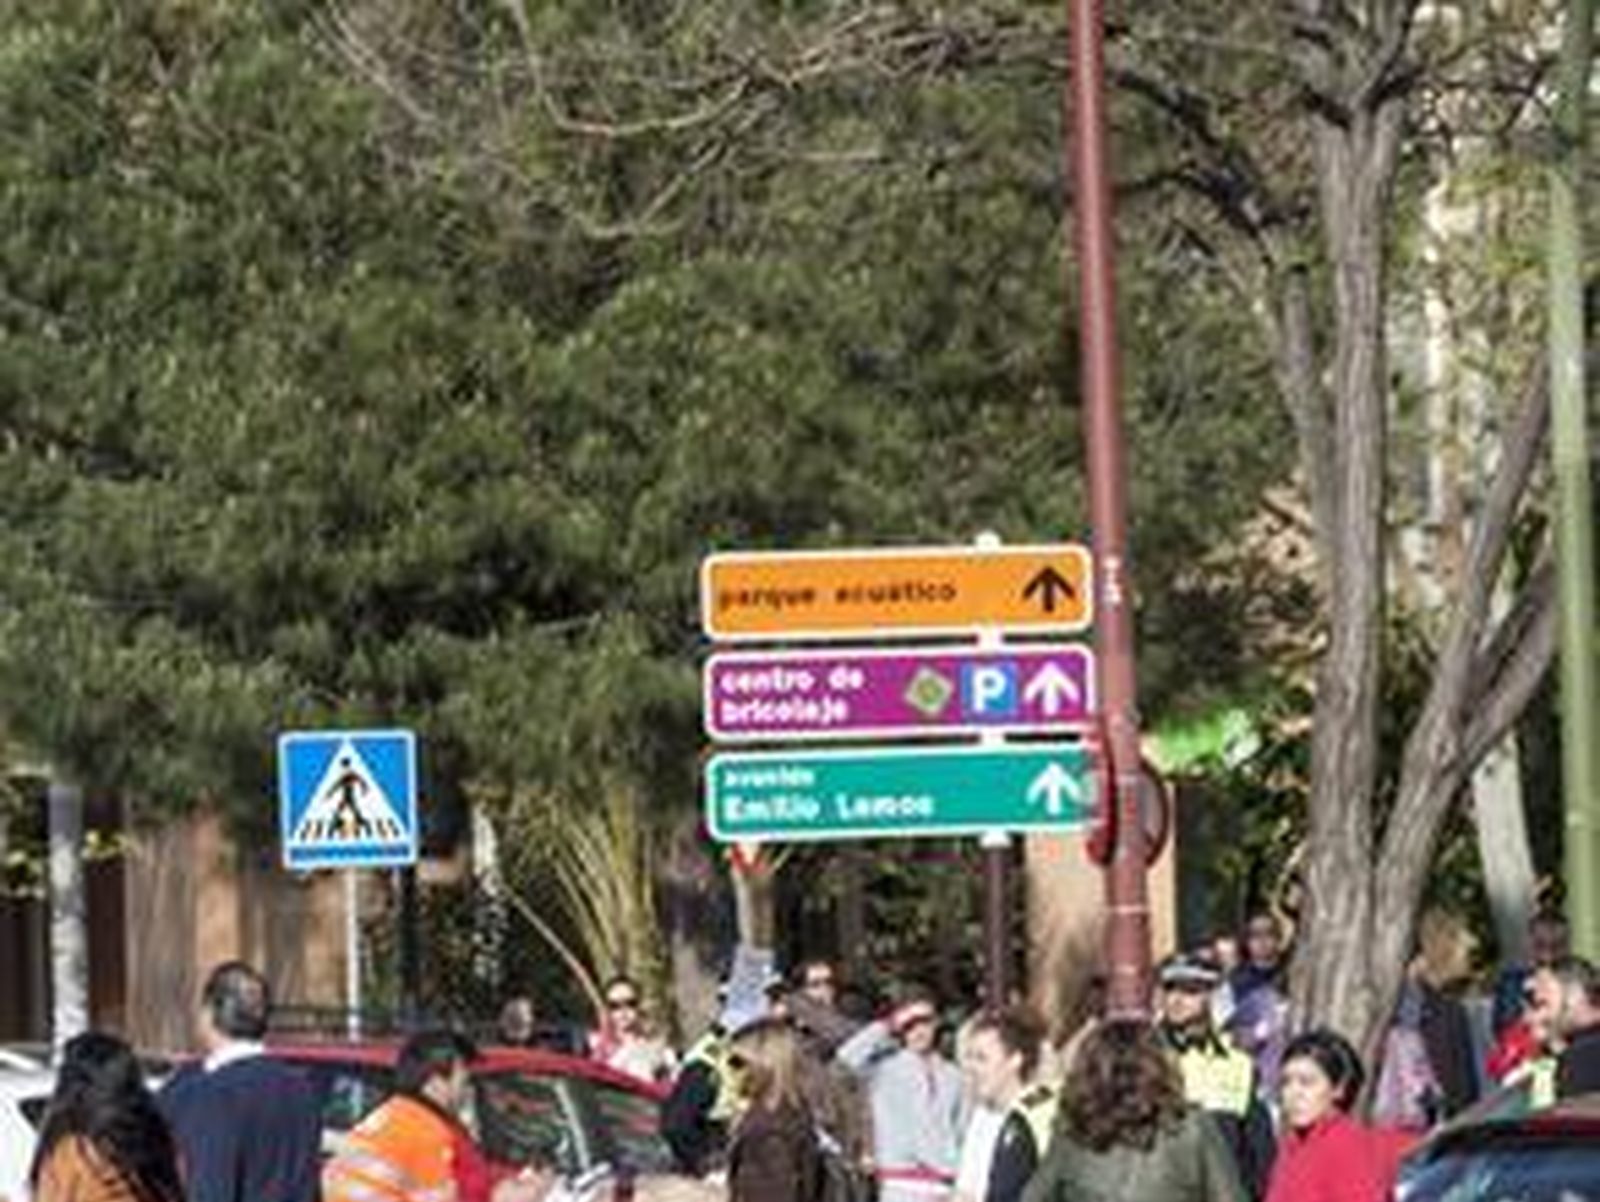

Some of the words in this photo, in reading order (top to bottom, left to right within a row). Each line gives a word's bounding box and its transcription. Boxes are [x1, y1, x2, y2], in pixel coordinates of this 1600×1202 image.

[720, 667, 816, 694] centro
[827, 665, 865, 690] de
[973, 668, 1006, 712] P
[721, 696, 848, 725] bricolaje
[724, 794, 821, 822] Emilio
